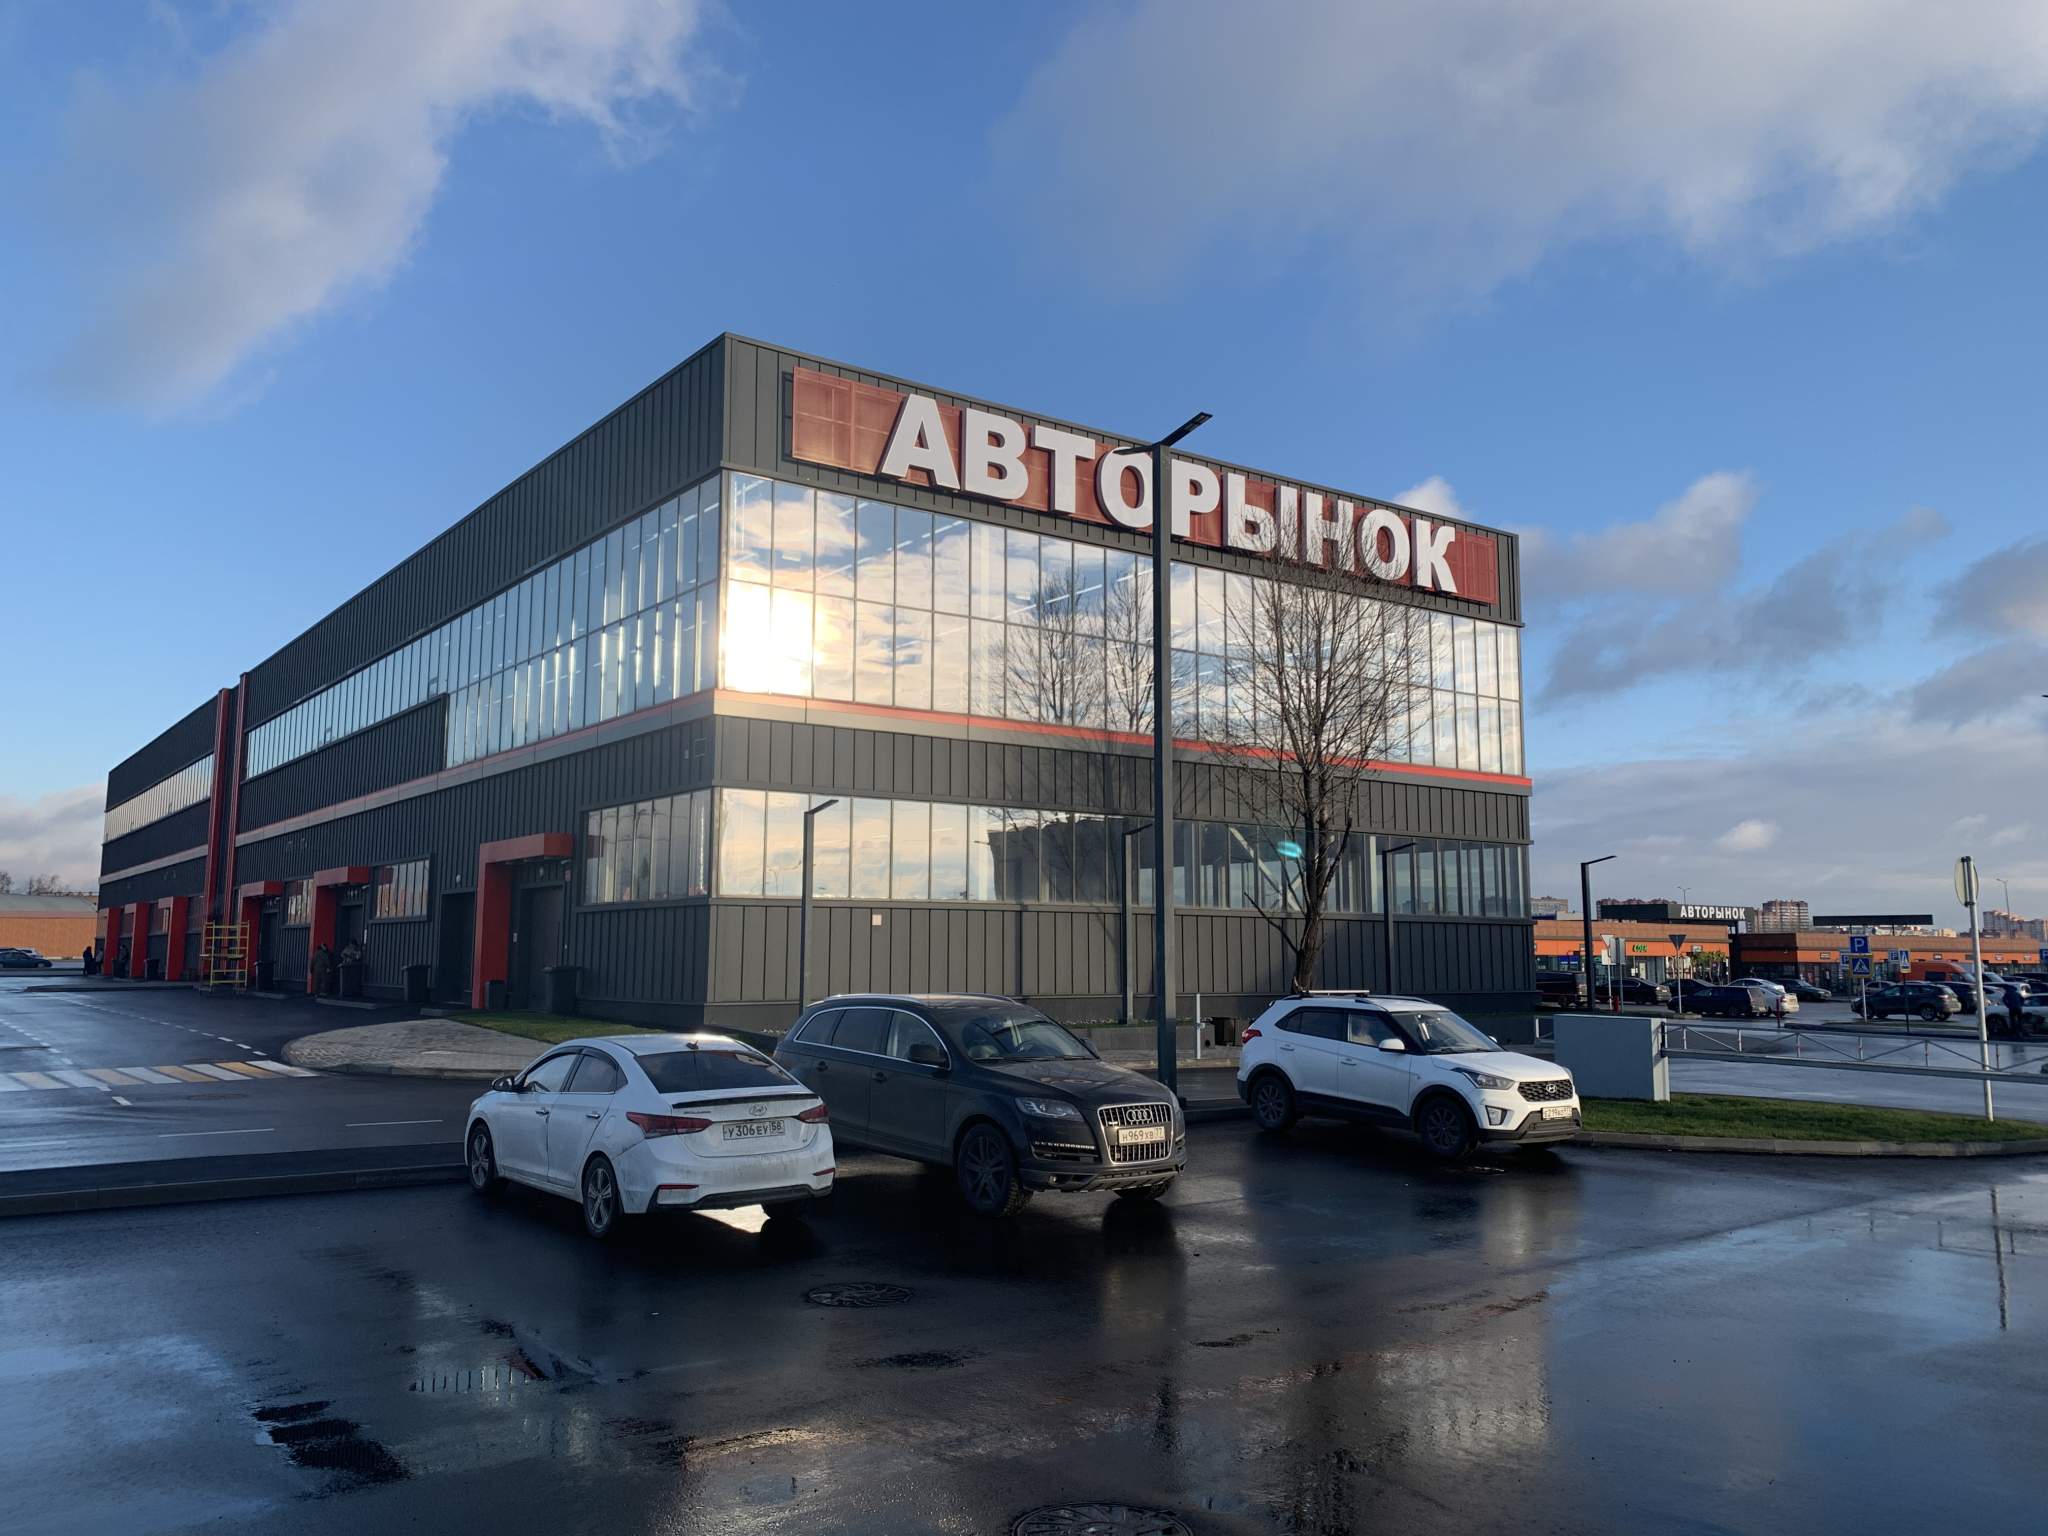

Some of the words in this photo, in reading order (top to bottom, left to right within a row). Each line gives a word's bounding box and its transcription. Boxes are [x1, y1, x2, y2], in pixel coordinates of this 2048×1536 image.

[880, 393, 1458, 593] АВТОРЫНОК
[1680, 905, 1746, 920] АВТОРЫНОК
[1854, 937, 1865, 952] P
